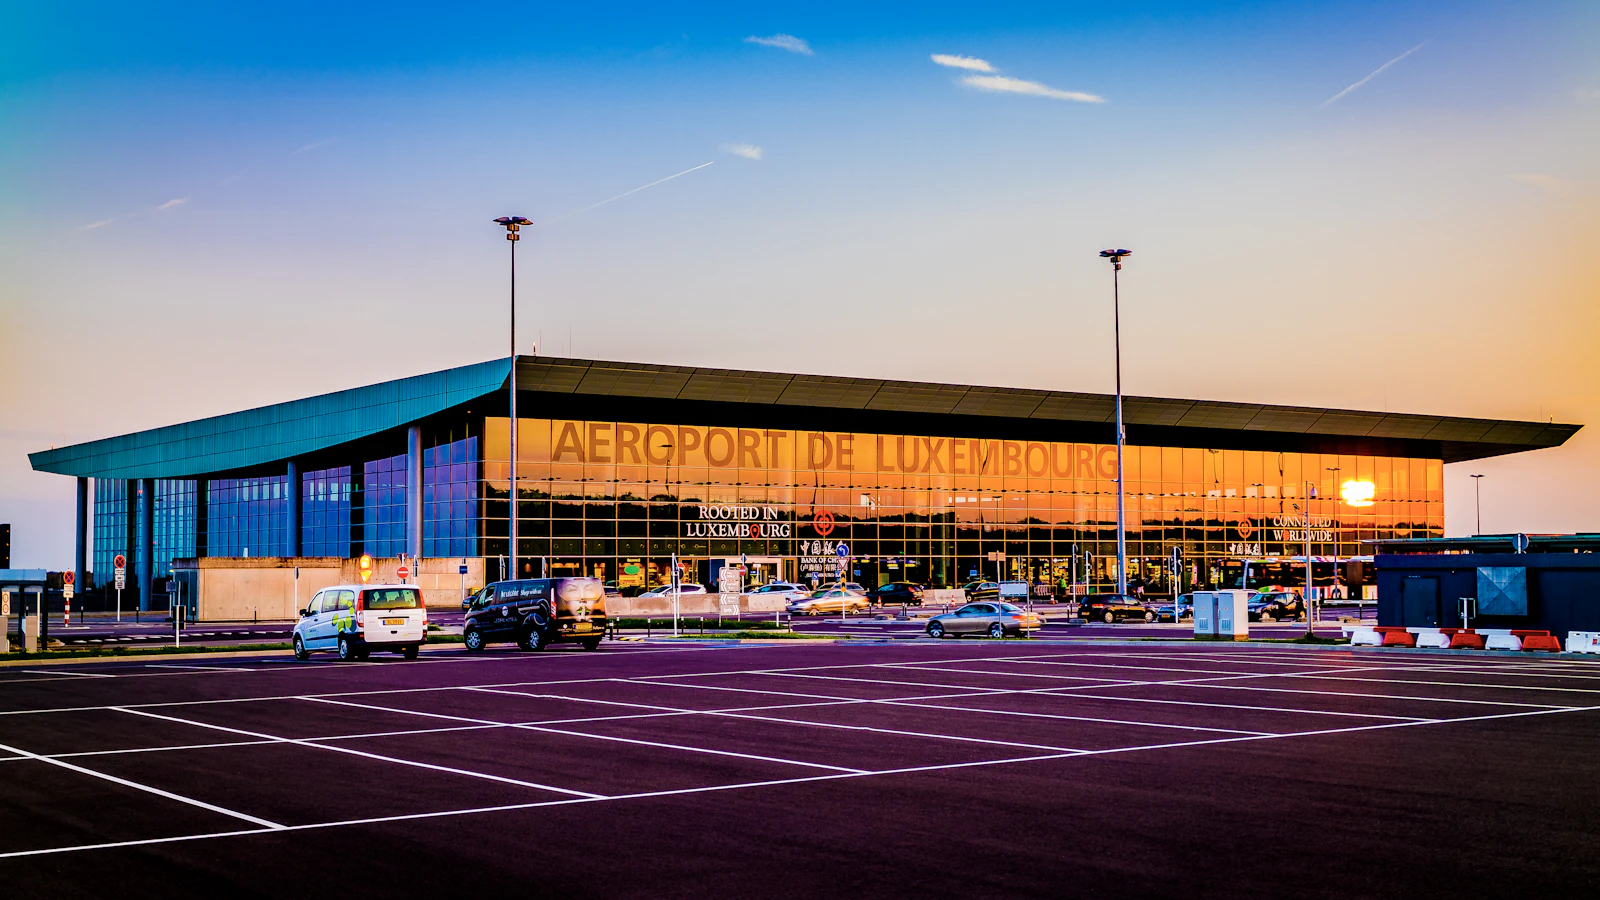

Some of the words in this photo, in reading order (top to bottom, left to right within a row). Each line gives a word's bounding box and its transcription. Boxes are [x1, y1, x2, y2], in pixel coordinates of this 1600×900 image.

[552, 422, 787, 469] AEROPORT
[808, 433, 855, 471] DE
[877, 436, 1118, 480] LUXEMBOURG
[698, 505, 760, 520] ROOTED
[762, 507, 779, 520] IN
[685, 523, 791, 538] LUXEMBOURG
